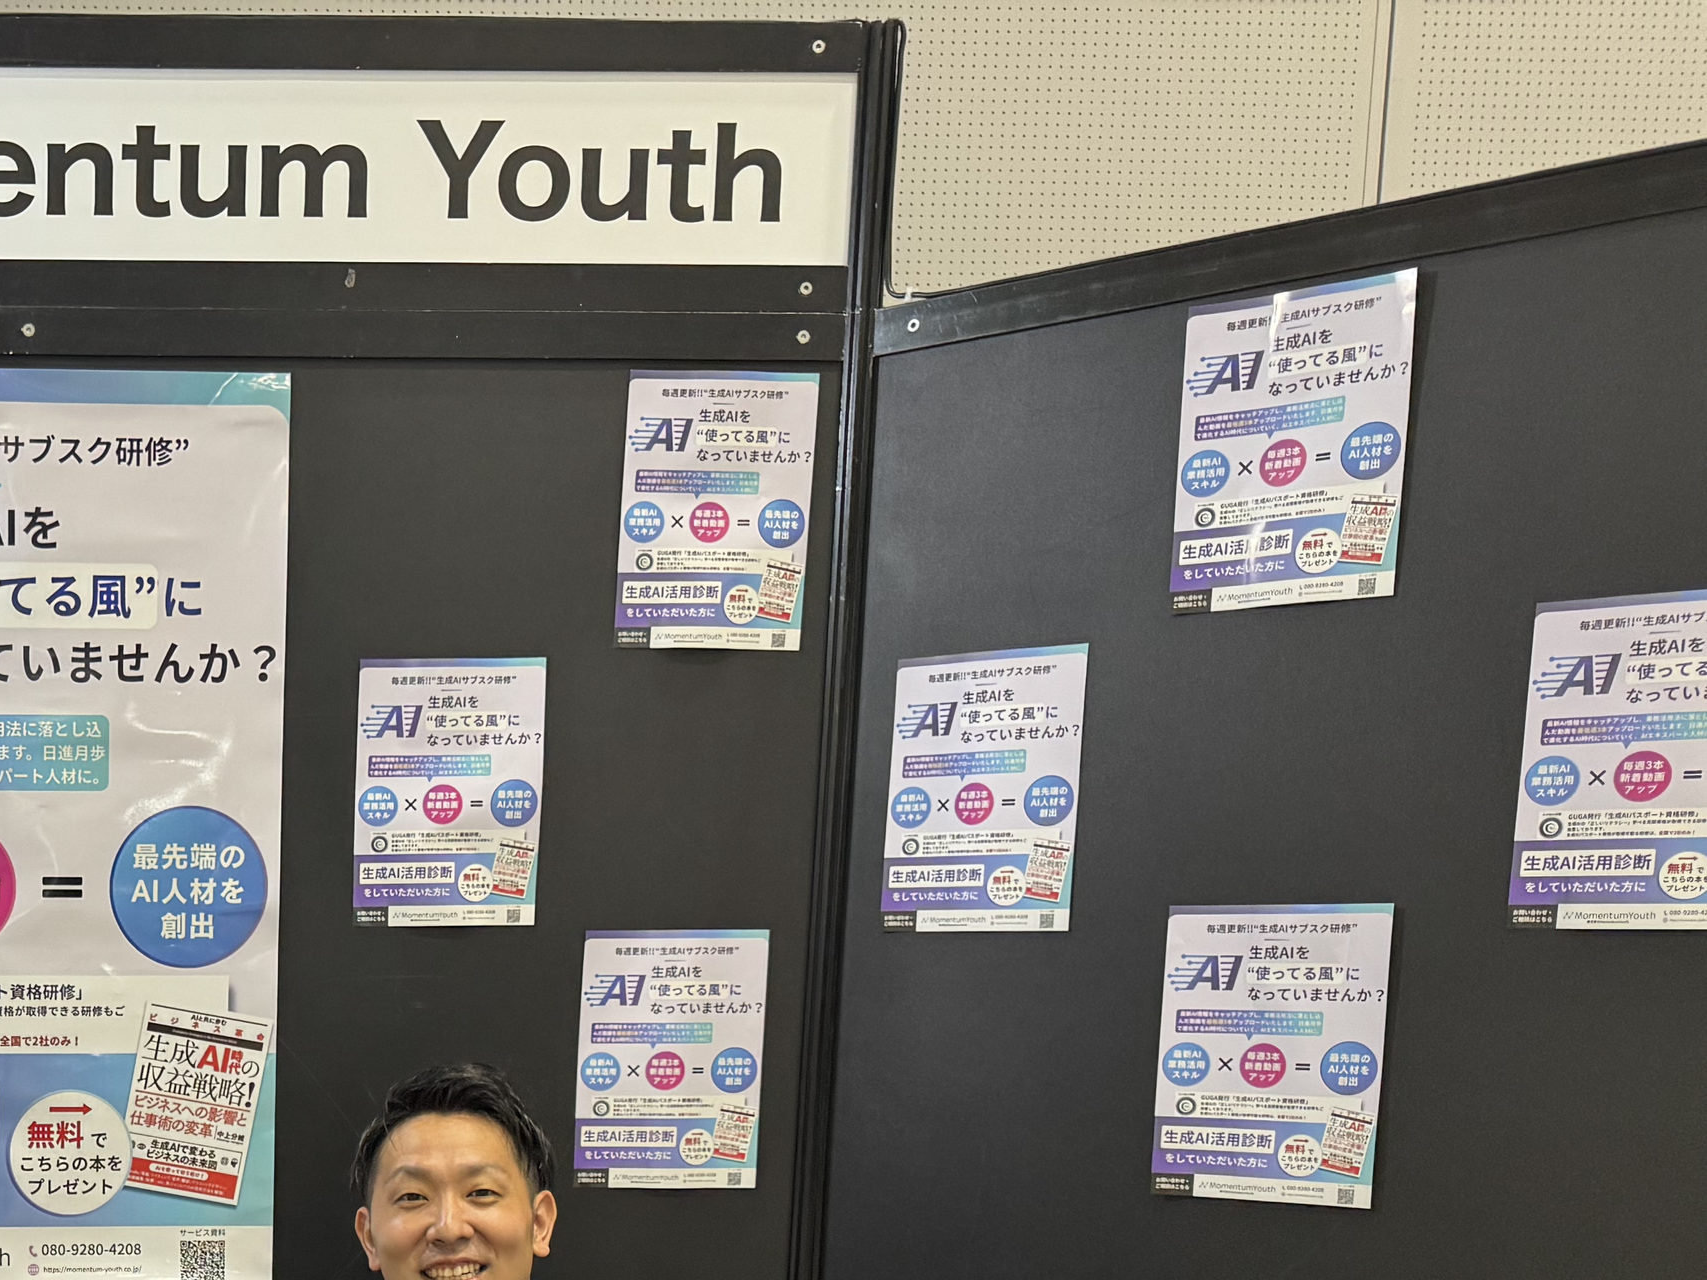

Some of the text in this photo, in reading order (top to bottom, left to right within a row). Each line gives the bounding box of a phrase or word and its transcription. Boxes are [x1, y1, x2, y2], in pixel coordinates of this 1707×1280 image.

[417, 118, 784, 223] Youth
[1267, 361, 1410, 397] なっていませんか？
[698, 408, 751, 423] 生成AIを
[696, 449, 811, 464] なっていませんか？
[625, 584, 719, 600] 生成AI活用診断
[1628, 635, 1706, 657] 生成AIを
[427, 695, 479, 709] 生成AIを
[962, 687, 1016, 705] 生成AIを
[427, 733, 541, 746] なっていませんか？
[960, 723, 1080, 744] なっていませんか？
[133, 843, 245, 869] 最先端の
[1523, 853, 1653, 872] 生成AI活用診断
[362, 866, 453, 880] 生成AI活用診断
[892, 868, 983, 883] 生成AI活用診断
[130, 877, 245, 905] AI人材を
[160, 912, 216, 940] 創出
[1248, 945, 1311, 960] 生成AIを
[651, 965, 702, 978] 生成AIを
[1246, 987, 1386, 1003] なっていませんか？
[650, 1002, 762, 1014] なっていませんか？
[141, 1034, 260, 1078] 生成AI時代の
[137, 1062, 255, 1107] 収益戦略!
[134, 1094, 247, 1127] ビジネスへの影響と
[130, 1110, 213, 1138] 仕事術の変革
[583, 1130, 674, 1143] 生成AI活用診断
[1165, 1129, 1273, 1149] 生成AI活用診断
[21, 1155, 122, 1174] こちらの本を
[29, 1177, 112, 1196] プレゼント
[41, 1243, 142, 1256] 080-9280-4208
